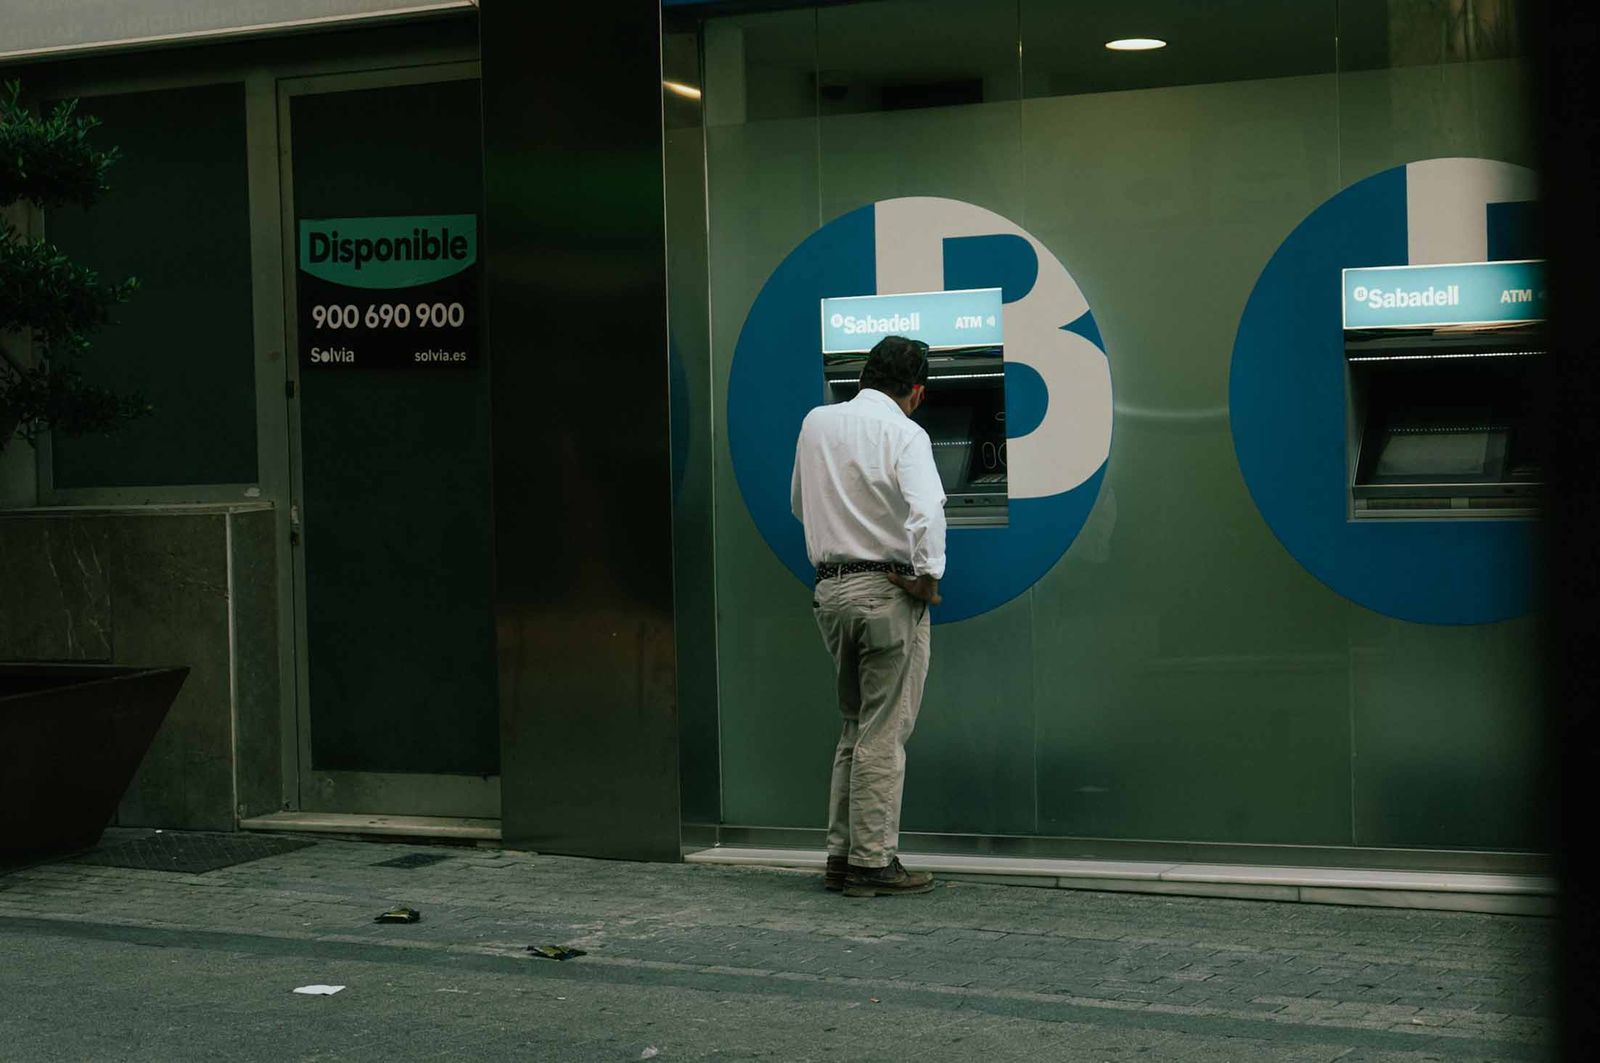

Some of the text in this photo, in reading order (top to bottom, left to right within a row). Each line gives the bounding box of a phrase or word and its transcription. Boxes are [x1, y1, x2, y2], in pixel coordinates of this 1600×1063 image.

[308, 228, 468, 270] Disponible
[1367, 285, 1460, 309] Sabadell
[1500, 289, 1532, 303] ATM
[312, 302, 465, 329] 900 690 900
[843, 312, 920, 334] Sabadell
[955, 316, 982, 330] ATM
[310, 347, 355, 363] Solvia
[414, 349, 467, 362] solvia.es
